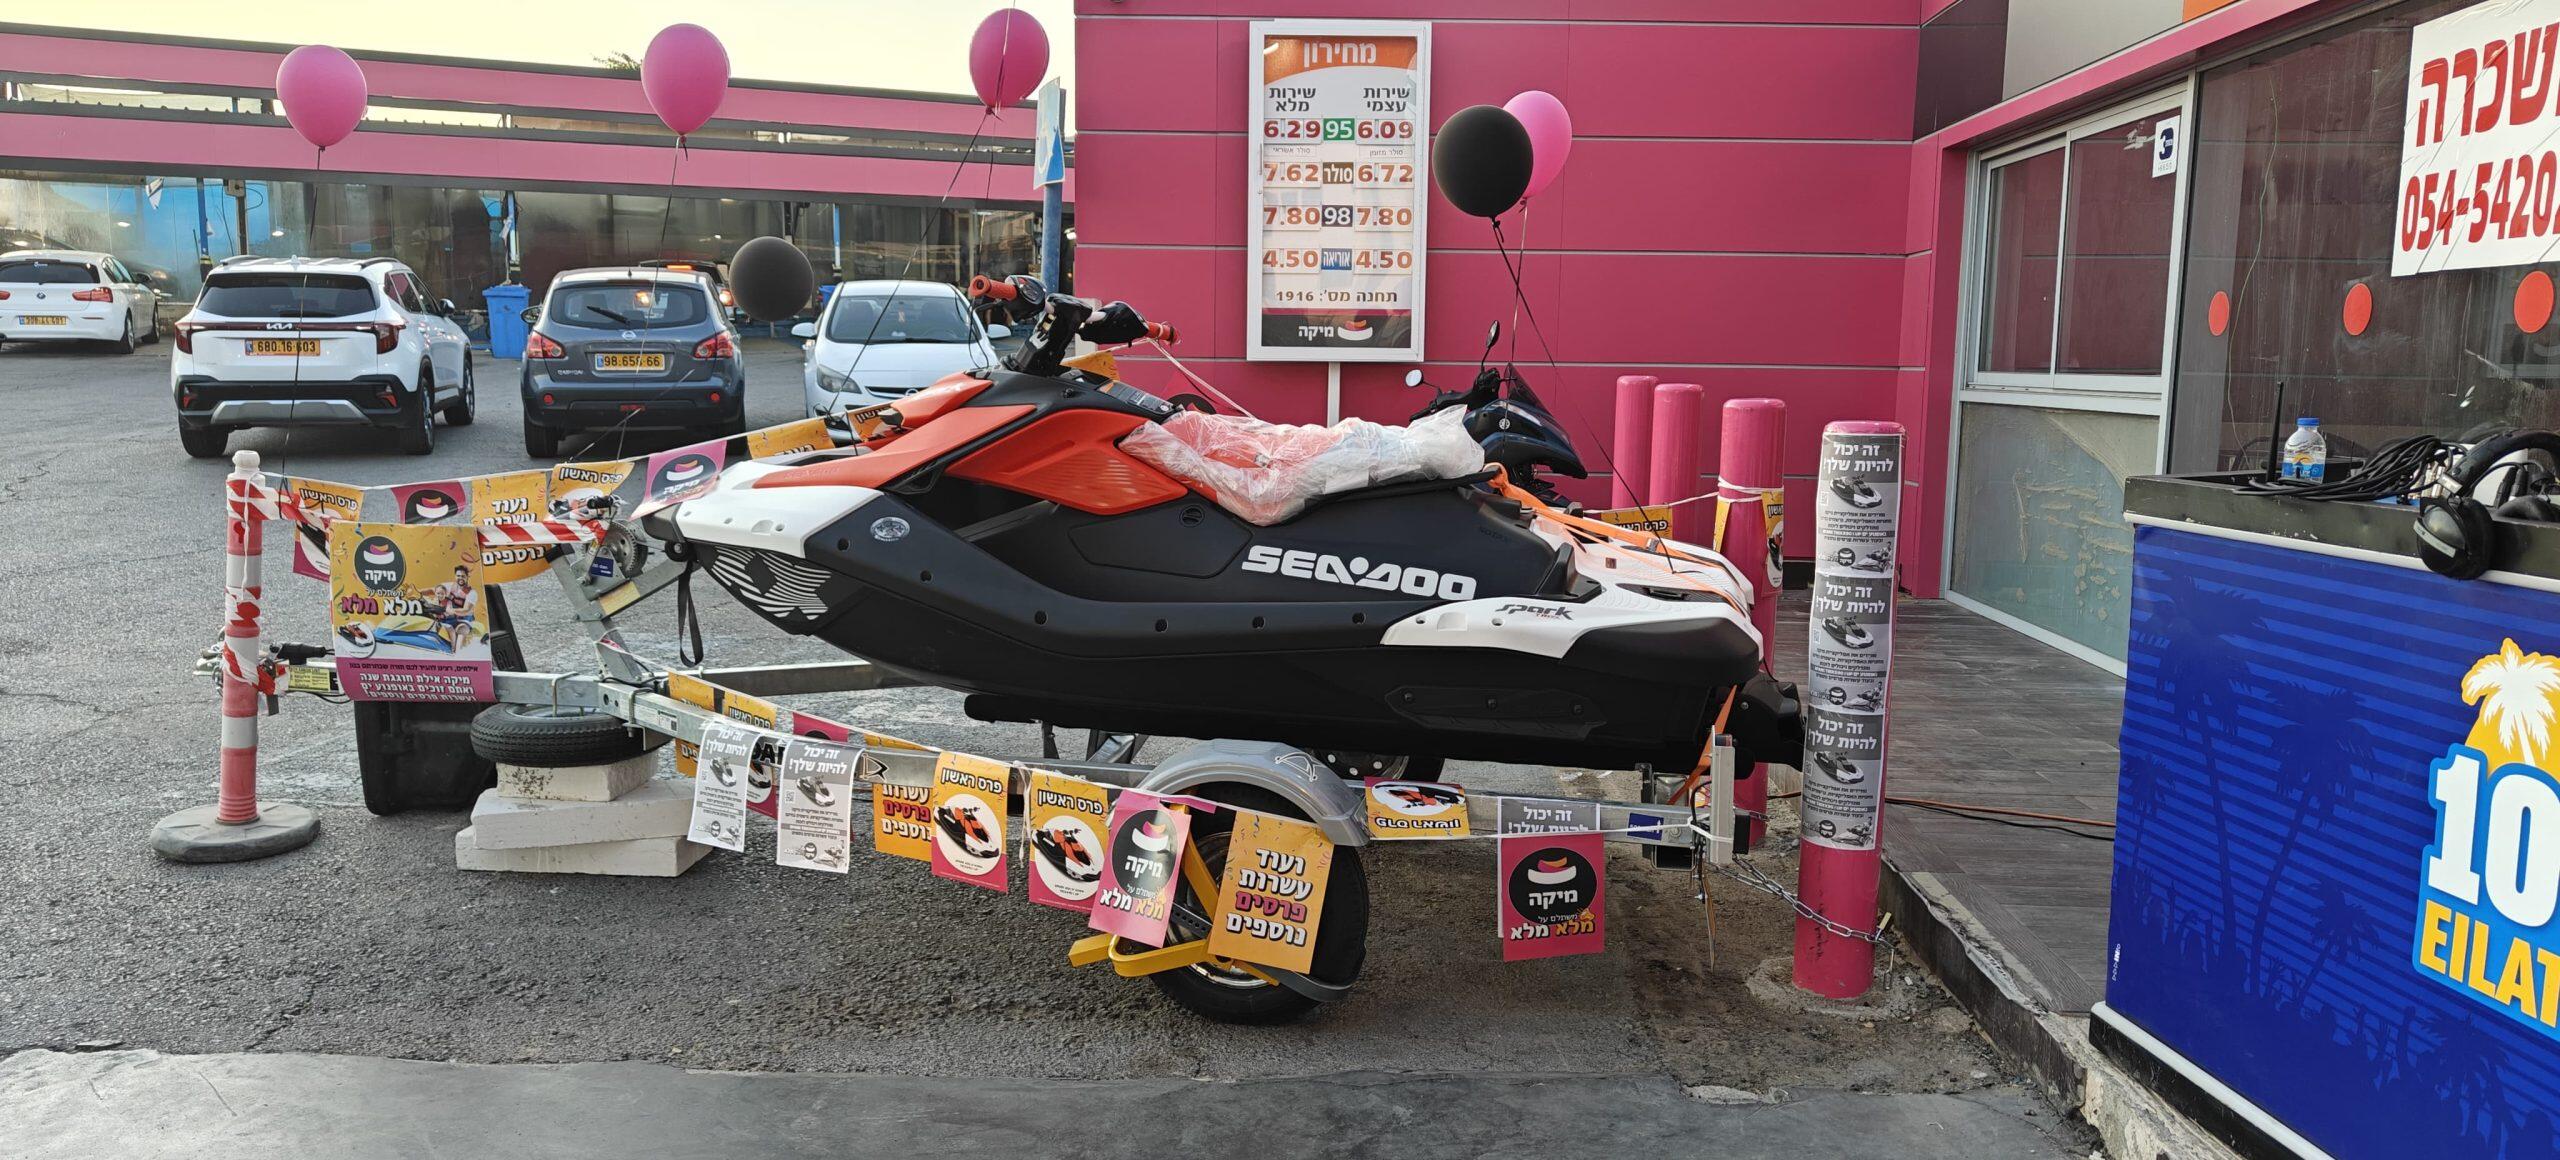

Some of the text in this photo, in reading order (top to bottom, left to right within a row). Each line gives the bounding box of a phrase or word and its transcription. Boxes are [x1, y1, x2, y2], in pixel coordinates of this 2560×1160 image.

[1304, 42, 1376, 67] מחירון
[2416, 22, 2560, 147] שכרה
[1269, 88, 1316, 99] שירות
[1363, 88, 1410, 99] שירות
[1276, 99, 1309, 112] מלא
[1367, 101, 1406, 112] עצמי
[1264, 120, 1413, 138] 6.29 95 6.09
[1264, 164, 1413, 183] 7.62 סולר 6.72
[2402, 151, 2560, 251] 054-5420
[1263, 207, 1412, 226] 7.80 98 7.80
[1263, 251, 1412, 269] 4.50 אוריאה 4.50
[1276, 291, 1314, 302] 1916
[1357, 292, 1397, 302] תחנה
[1299, 325, 1334, 341] מיקה
[1833, 442, 1880, 456] זה יכול
[1854, 459, 1894, 472] להיות
[560, 467, 598, 484] ראשון
[300, 488, 358, 510] פרס ראשון
[492, 497, 528, 514] ועוד
[482, 546, 546, 566] נוספים
[365, 570, 396, 585] מיקה
[1825, 582, 1872, 598] זה יכול
[342, 593, 423, 615] מלא מלא
[1847, 600, 1885, 614] להיות
[360, 673, 470, 687] מיקה אילת חוגגת שנה
[375, 682, 415, 692] באופנוע
[419, 684, 445, 692] זוכים
[448, 686, 474, 694] ואתם
[1817, 716, 1864, 735] זה יכול
[725, 743, 747, 756] להיות
[1838, 736, 1877, 750] להיות
[804, 745, 840, 759] זה יכול
[816, 762, 847, 775] להיות
[941, 768, 1003, 794] פרס ראשון
[1038, 789, 1103, 815] פרס ראשון
[883, 799, 931, 823] פרסים
[1524, 806, 1572, 821] זה יכול
[1125, 855, 1163, 878] מיקה
[1256, 848, 1305, 875] ועוד
[1239, 869, 1312, 901] עשרות
[1100, 888, 1133, 911] מלא
[1235, 891, 1307, 923] פרסים
[1529, 889, 1578, 910] מיקה
[1135, 898, 1164, 920] מלא
[1538, 915, 1548, 923] על
[1227, 913, 1306, 946] נוספים
[1511, 919, 1594, 940] מלא מלא
